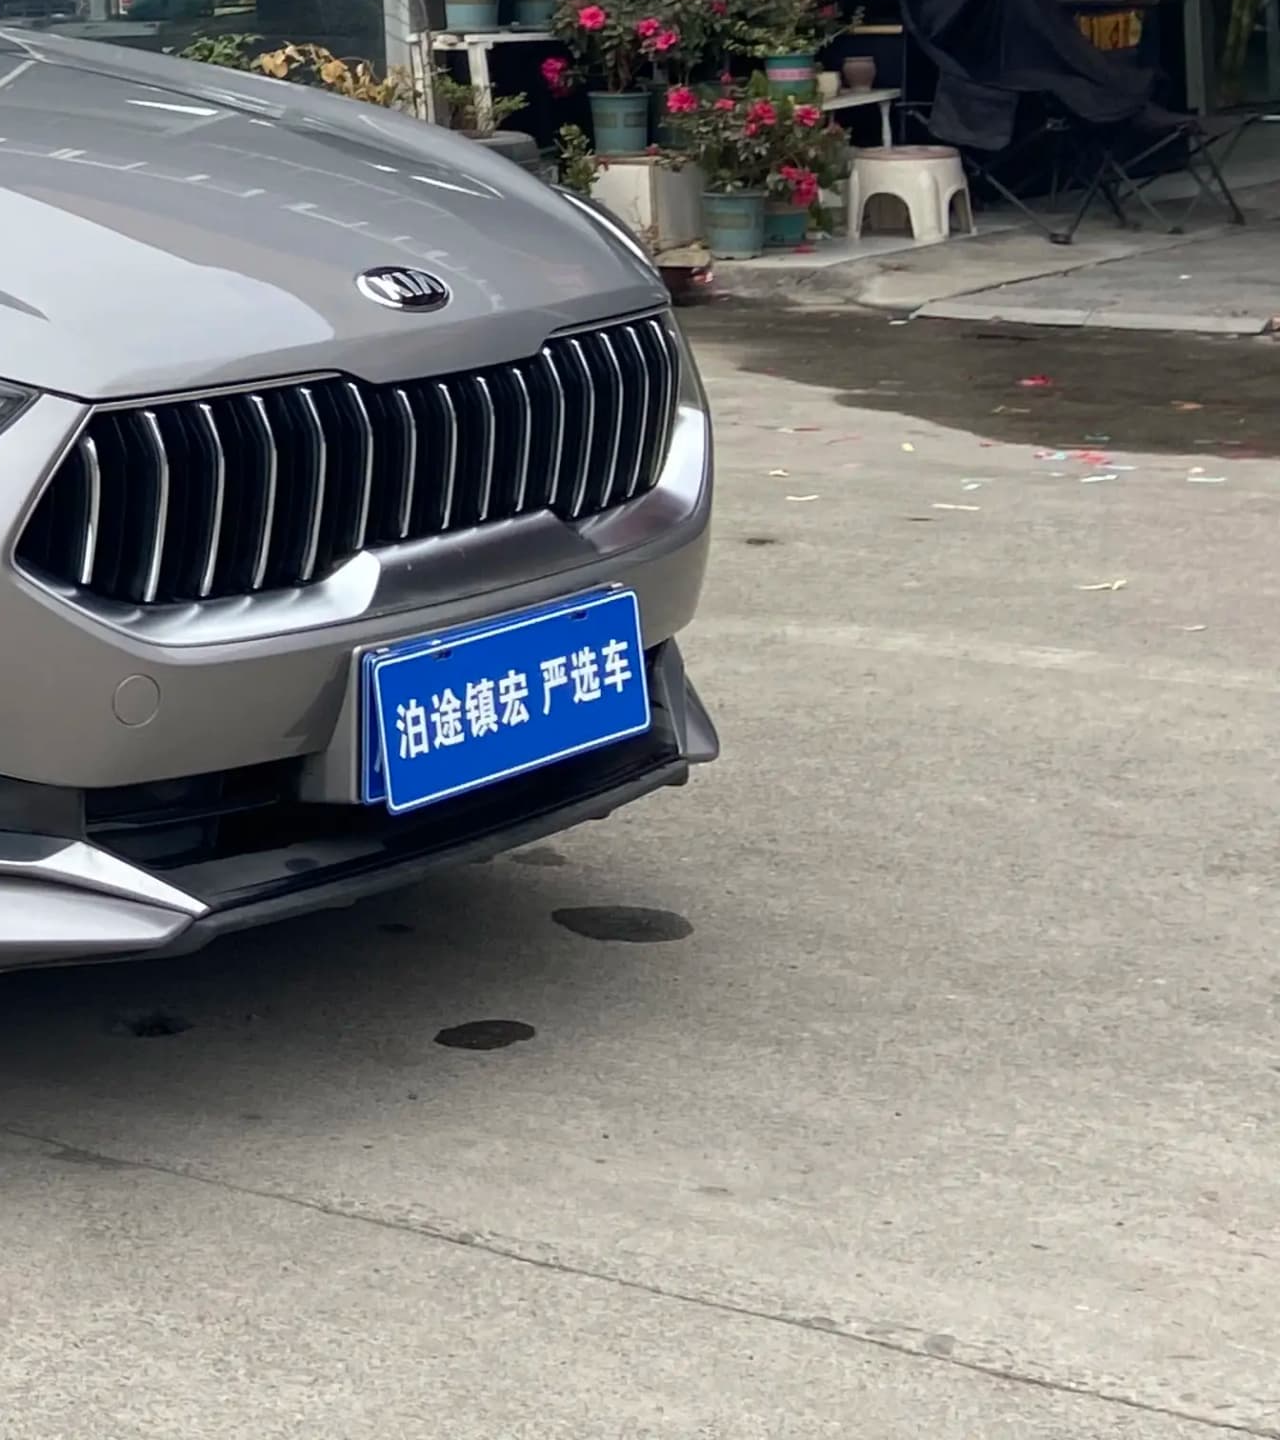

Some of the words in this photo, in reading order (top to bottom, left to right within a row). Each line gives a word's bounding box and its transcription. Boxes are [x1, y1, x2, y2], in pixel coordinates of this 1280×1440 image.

[395, 669, 530, 759] 泊途镇宏
[540, 639, 633, 716] 严选车
